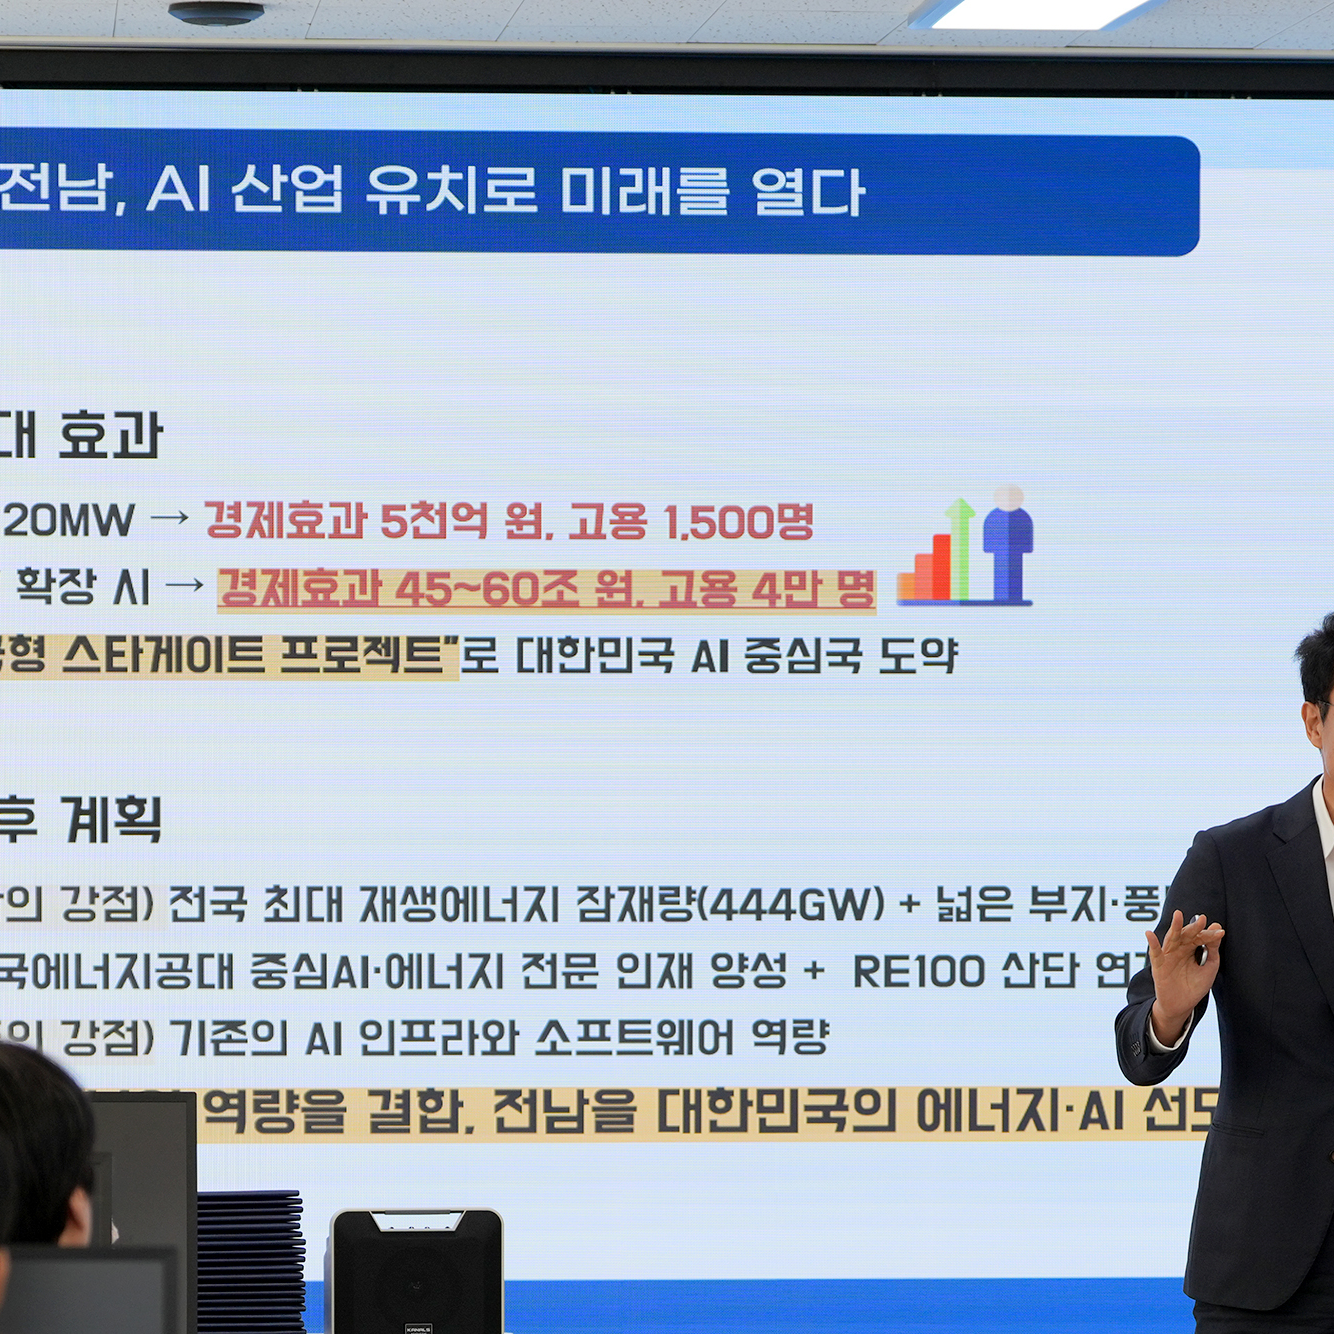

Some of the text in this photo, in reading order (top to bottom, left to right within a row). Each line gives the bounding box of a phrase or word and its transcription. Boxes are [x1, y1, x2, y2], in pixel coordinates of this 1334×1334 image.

[146, 165, 209, 211] AI
[232, 165, 341, 213] 산업
[367, 165, 537, 215] 유치로
[563, 167, 730, 215] 미래를
[753, 168, 866, 217] 열다
[60, 410, 164, 459] 효과
[4, 503, 135, 536] 20MW
[205, 500, 368, 539] 경제효과
[382, 501, 487, 539] 5천억
[505, 502, 553, 540] 원,
[569, 503, 647, 540] 고용
[665, 504, 813, 541] 1,500명
[17, 567, 97, 605] 확장
[114, 569, 148, 605] 시
[219, 568, 382, 607] 경제효과
[395, 570, 580, 607] 45~60조
[595, 570, 646, 608] 원,
[658, 570, 737, 607] 고용
[752, 570, 822, 607] 4만
[838, 570, 875, 607] 명
[63, 636, 265, 673] 스타게이트
[517, 636, 674, 673] 대한민국
[692, 639, 728, 672] AI
[745, 638, 863, 674] 중심국
[880, 638, 958, 674] 도약
[61, 795, 160, 843] 계획
[61, 886, 153, 922] 강점)
[170, 886, 247, 922] 전국
[265, 885, 342, 922] 최대
[360, 886, 558, 922] 재생에너지
[937, 886, 1013, 922] 넓은
[1027, 885, 1171, 923] 부지·풍
[523, 953, 599, 989] 전문
[617, 953, 692, 989] 인재
[711, 953, 786, 989] 양성
[855, 955, 985, 987] RE100
[1003, 953, 1080, 988] 산단
[61, 1020, 154, 1056] 강점)
[171, 1020, 287, 1056] 기존의
[306, 1022, 341, 1055] AI
[360, 1020, 520, 1056] 인프라와
[535, 1019, 733, 1055] 소프트웨어
[752, 1019, 829, 1055] 역량
[204, 1090, 347, 1134] 역량을
[368, 1088, 474, 1134] 결합,
[495, 1089, 637, 1134] 전남을
[659, 1087, 896, 1133] 대한민국의
